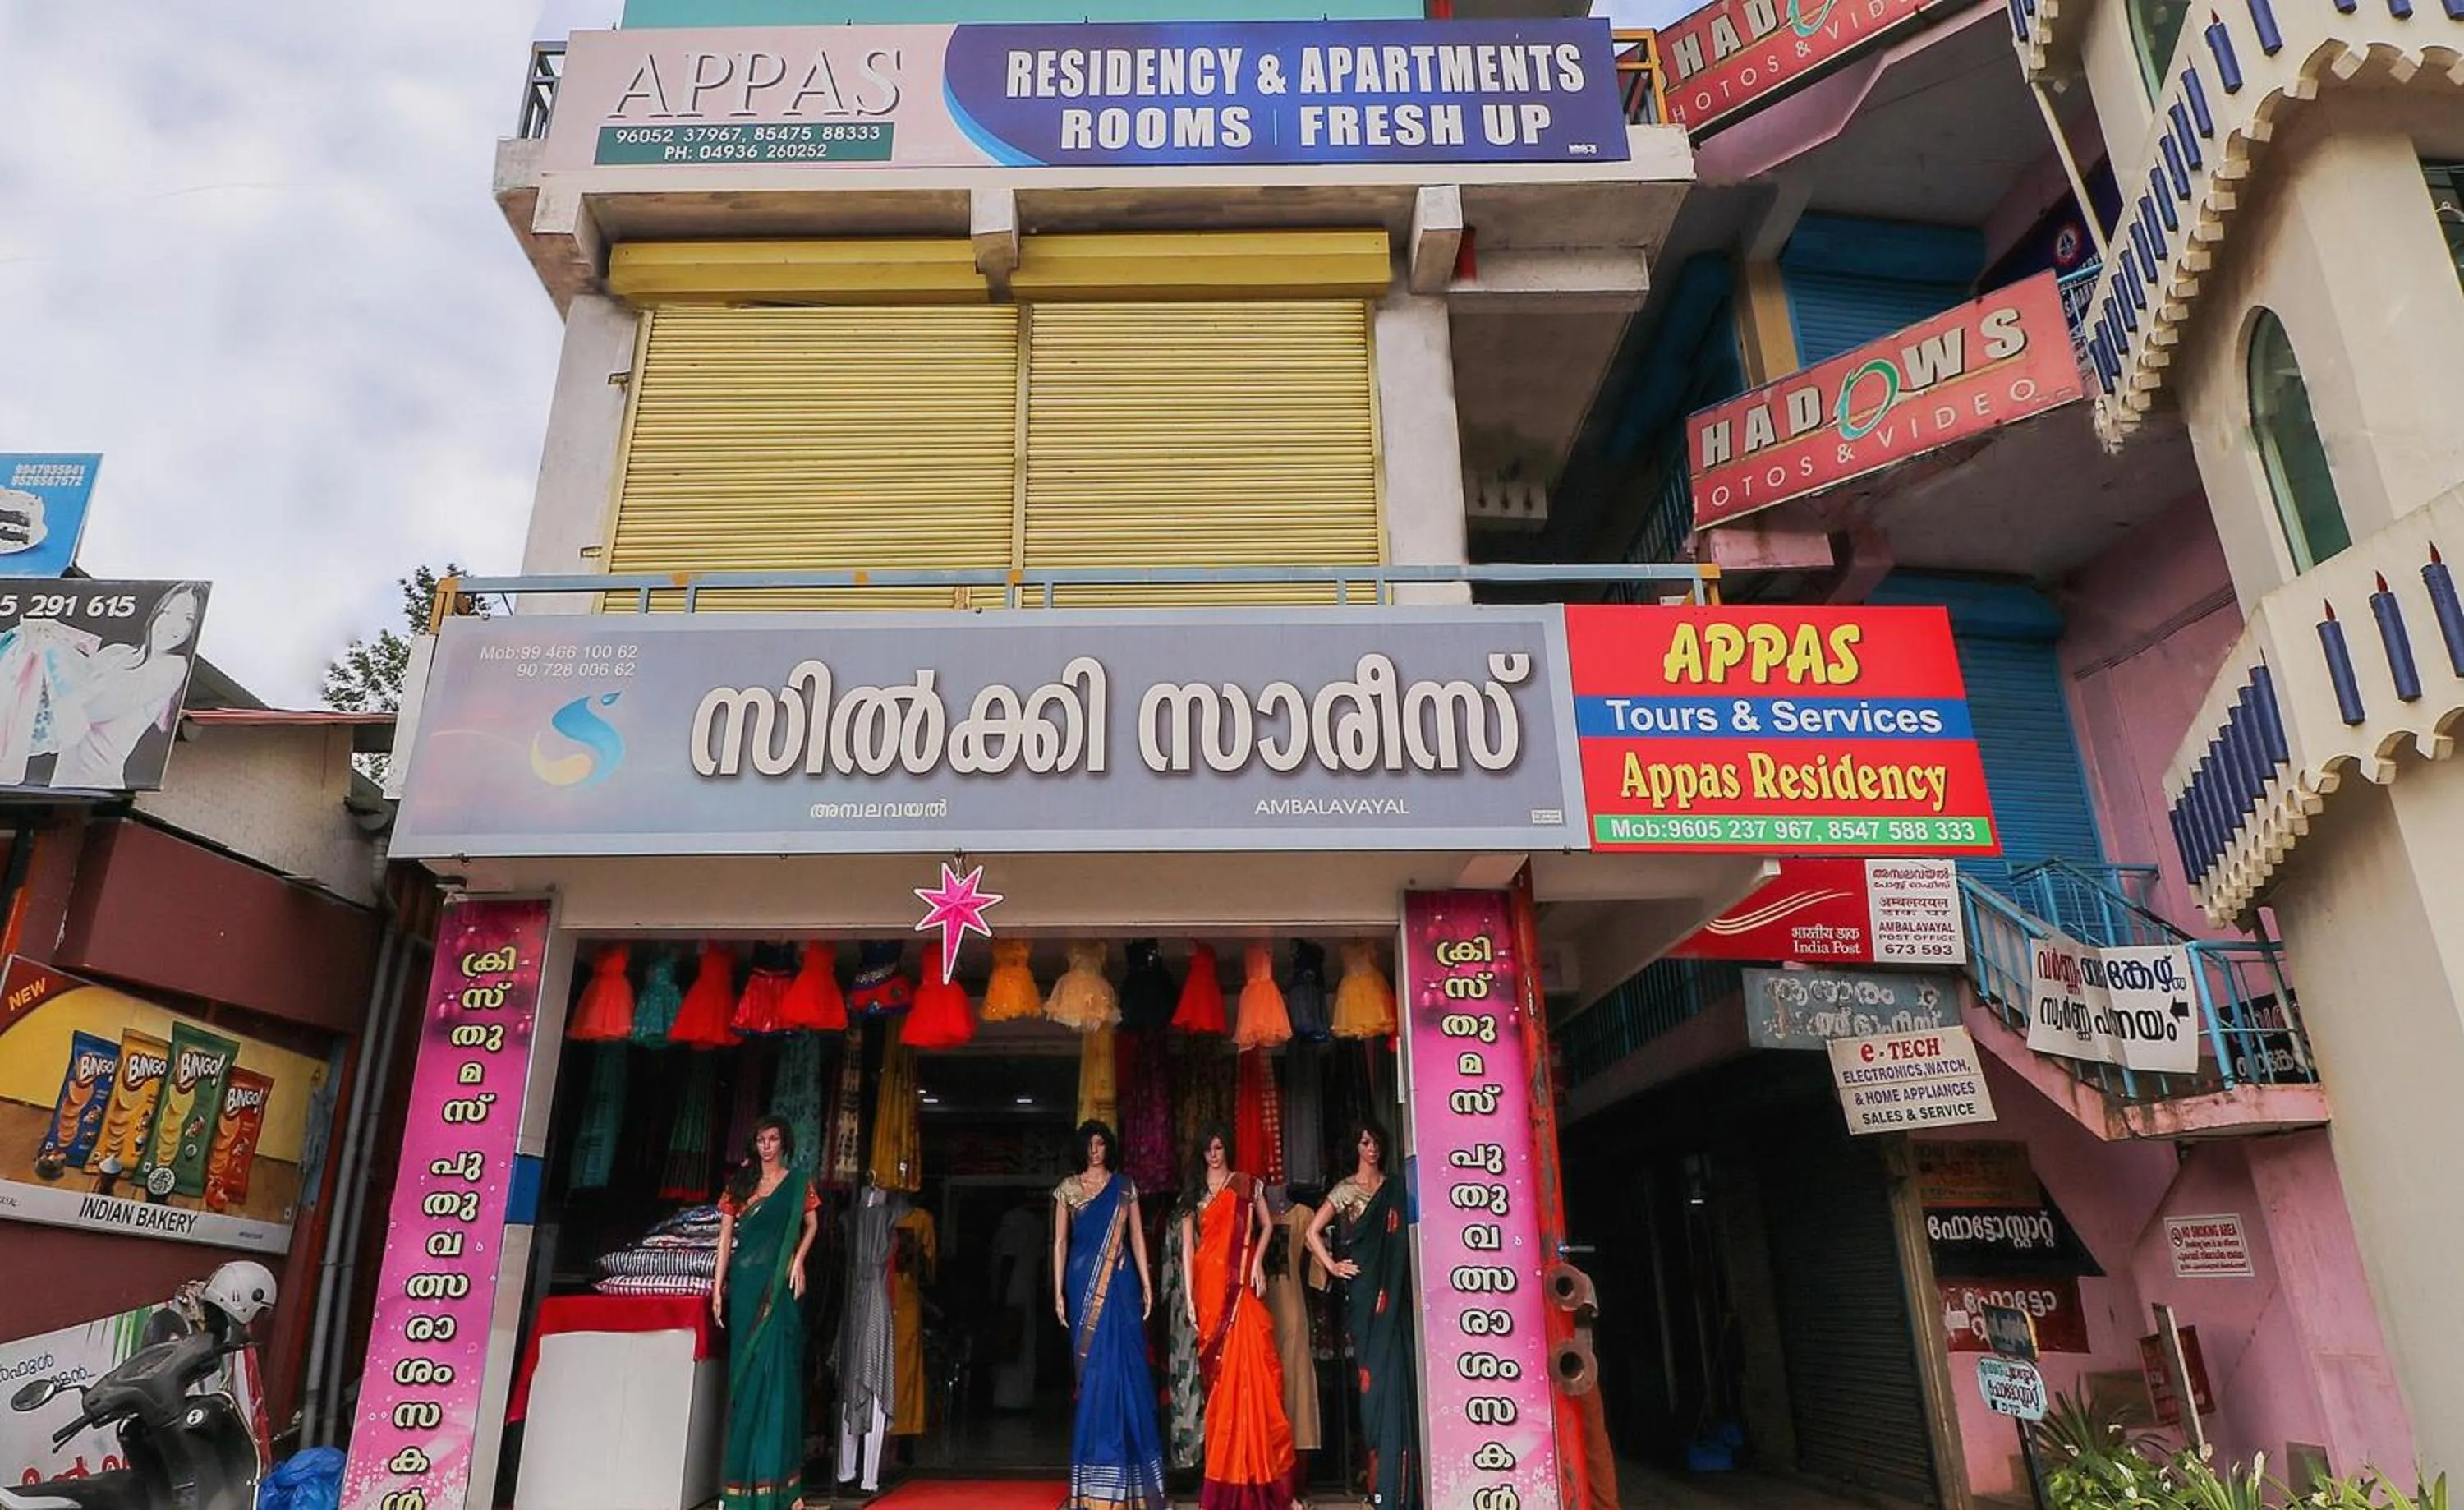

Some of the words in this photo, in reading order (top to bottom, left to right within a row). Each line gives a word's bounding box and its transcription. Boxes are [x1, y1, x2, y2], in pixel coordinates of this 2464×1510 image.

[1794, 40, 1812, 58] &
[1006, 48, 1242, 98] RESIDENCY
[1256, 53, 1289, 95] &
[1300, 43, 1584, 94] APARTMENTS
[607, 49, 901, 120] APPAS
[616, 128, 674, 144] 96052
[683, 127, 747, 145] 37967,
[754, 126, 812, 141] 85475
[822, 125, 881, 140] 88333
[1060, 106, 1252, 150] ROOMS
[1300, 104, 1465, 148] FRESH
[1482, 103, 1551, 145] UP
[663, 145, 693, 160] PH:
[699, 144, 759, 159] 04936
[767, 143, 827, 159] 260252
[1836, 442, 1855, 465] &
[1877, 378, 2036, 450] VIDEO
[25, 594, 77, 618] 291
[86, 594, 136, 618] 615
[545, 643, 578, 660] 466
[584, 643, 614, 659] 100
[617, 643, 639, 659] 62
[1663, 622, 1861, 685] APPAS
[517, 663, 540, 679] 90
[543, 662, 574, 678] 728
[578, 662, 610, 678] 006
[614, 661, 636, 677] 62
[1138, 652, 1532, 772] സാരീസ്
[1606, 699, 1719, 732] Tours
[1731, 700, 1762, 732] &
[1772, 700, 1943, 734] Services
[1620, 751, 1741, 809] Appas
[1747, 752, 1947, 812] Residency
[1254, 798, 1410, 816] AMBALAVAYAL
[1729, 819, 1767, 840] 237
[1829, 820, 1878, 840] 8547
[1890, 820, 1929, 840] 588
[1936, 820, 1976, 841] 333
[1878, 921, 1956, 933] AMBALAVAYAL
[1878, 933, 1911, 941] POST
[1913, 933, 1956, 942] OFFICE
[1793, 940, 1830, 954] India
[1832, 941, 1862, 955] Post
[1885, 944, 1916, 955] 673
[1921, 944, 1954, 955] 593
[7, 977, 47, 1011] NEW
[179, 1052, 226, 1087] BINGO!
[1854, 1091, 1865, 1107] &
[1865, 1088, 1901, 1106] HOME
[1903, 1080, 1977, 1102] APPLIANCES
[1861, 1109, 1904, 1126] SALES
[1906, 1107, 1918, 1122] &
[1919, 1102, 1977, 1121] SERVICE
[80, 1196, 135, 1225] INDIAN
[136, 1205, 198, 1235] BAKERY
